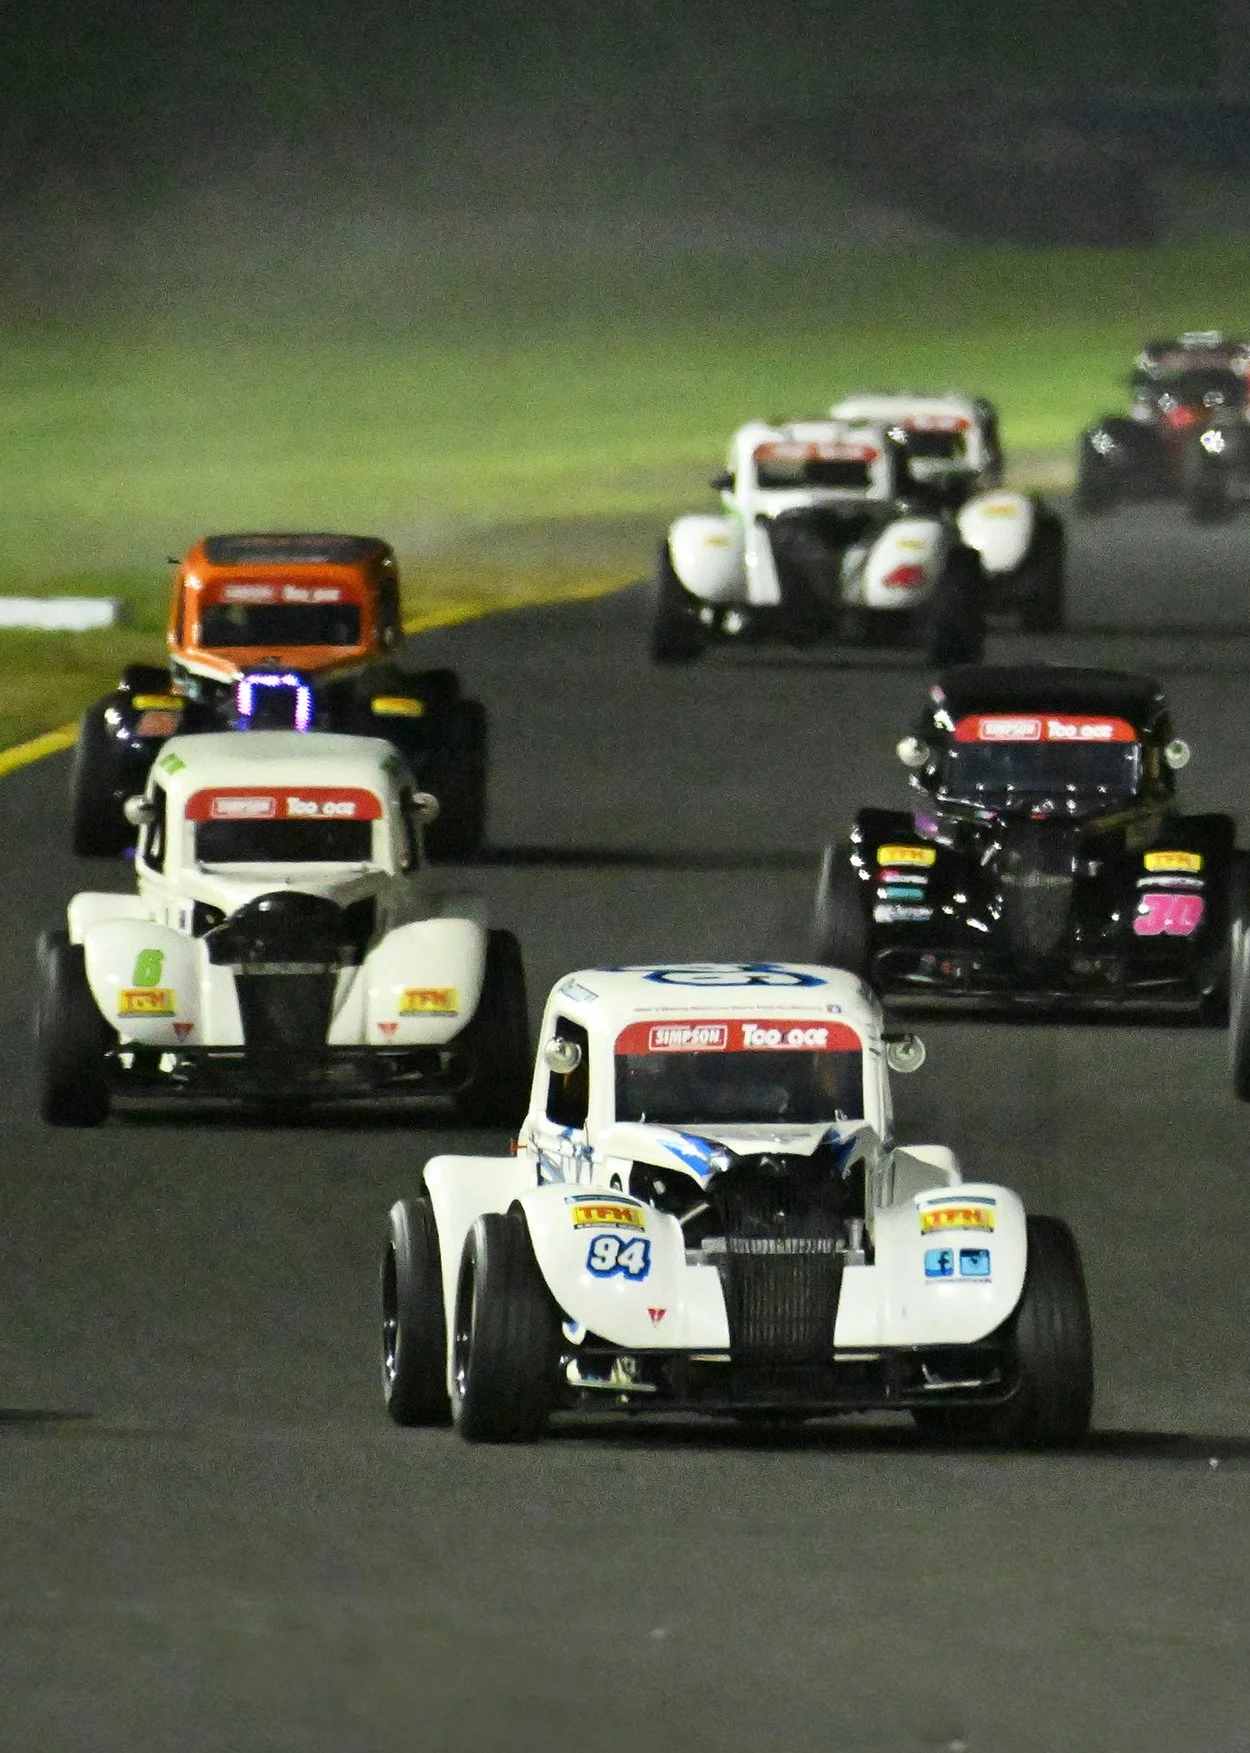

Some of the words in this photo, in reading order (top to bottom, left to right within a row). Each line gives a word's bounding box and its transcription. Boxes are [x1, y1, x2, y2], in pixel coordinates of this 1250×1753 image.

[131, 948, 165, 987] 6
[654, 1026, 722, 1046] SIMPSON
[586, 1234, 651, 1281] 94
